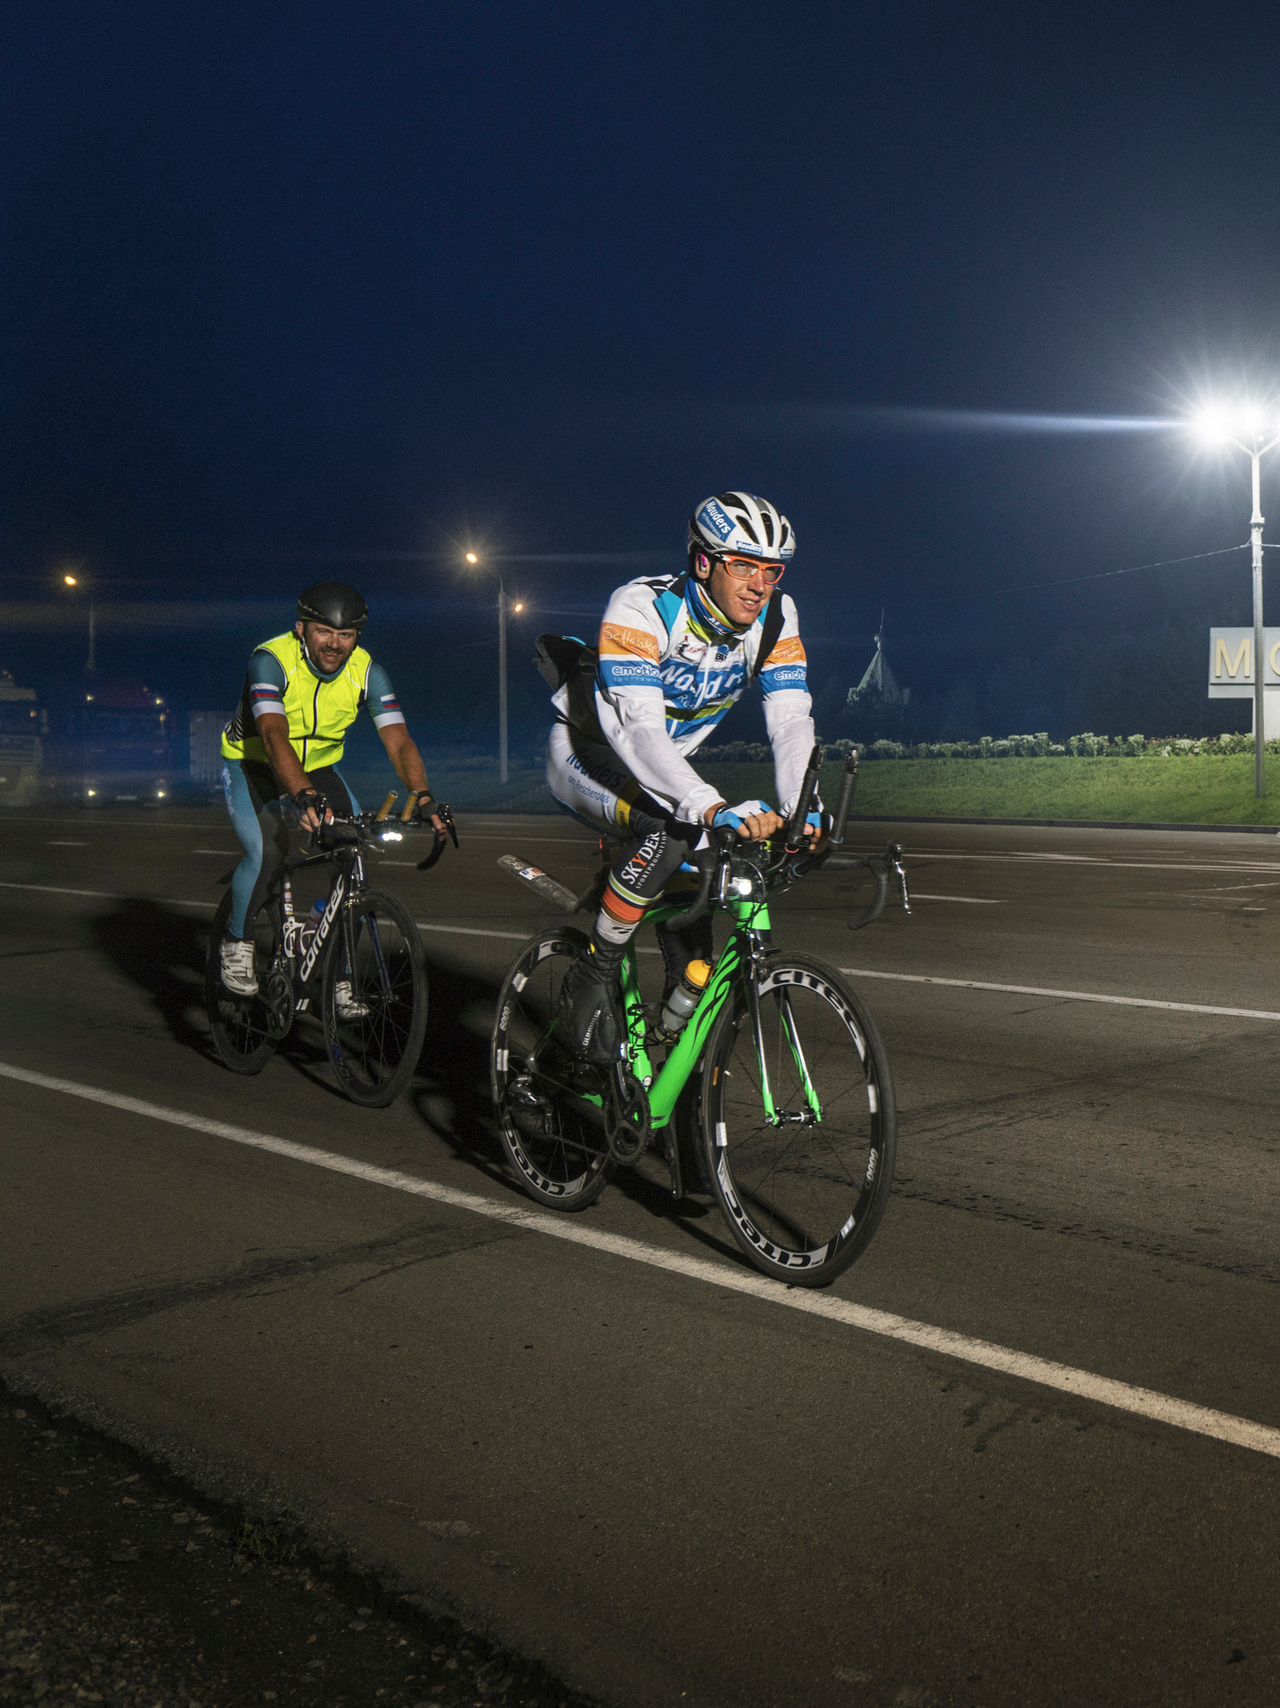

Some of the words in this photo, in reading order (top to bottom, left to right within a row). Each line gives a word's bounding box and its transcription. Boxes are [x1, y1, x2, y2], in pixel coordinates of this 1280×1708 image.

[706, 501, 731, 534] Nauders
[566, 752, 627, 789] Nauders
[621, 831, 660, 885] SKYDER
[635, 830, 667, 889] SPORTPROMOTION
[300, 874, 345, 982] corratec
